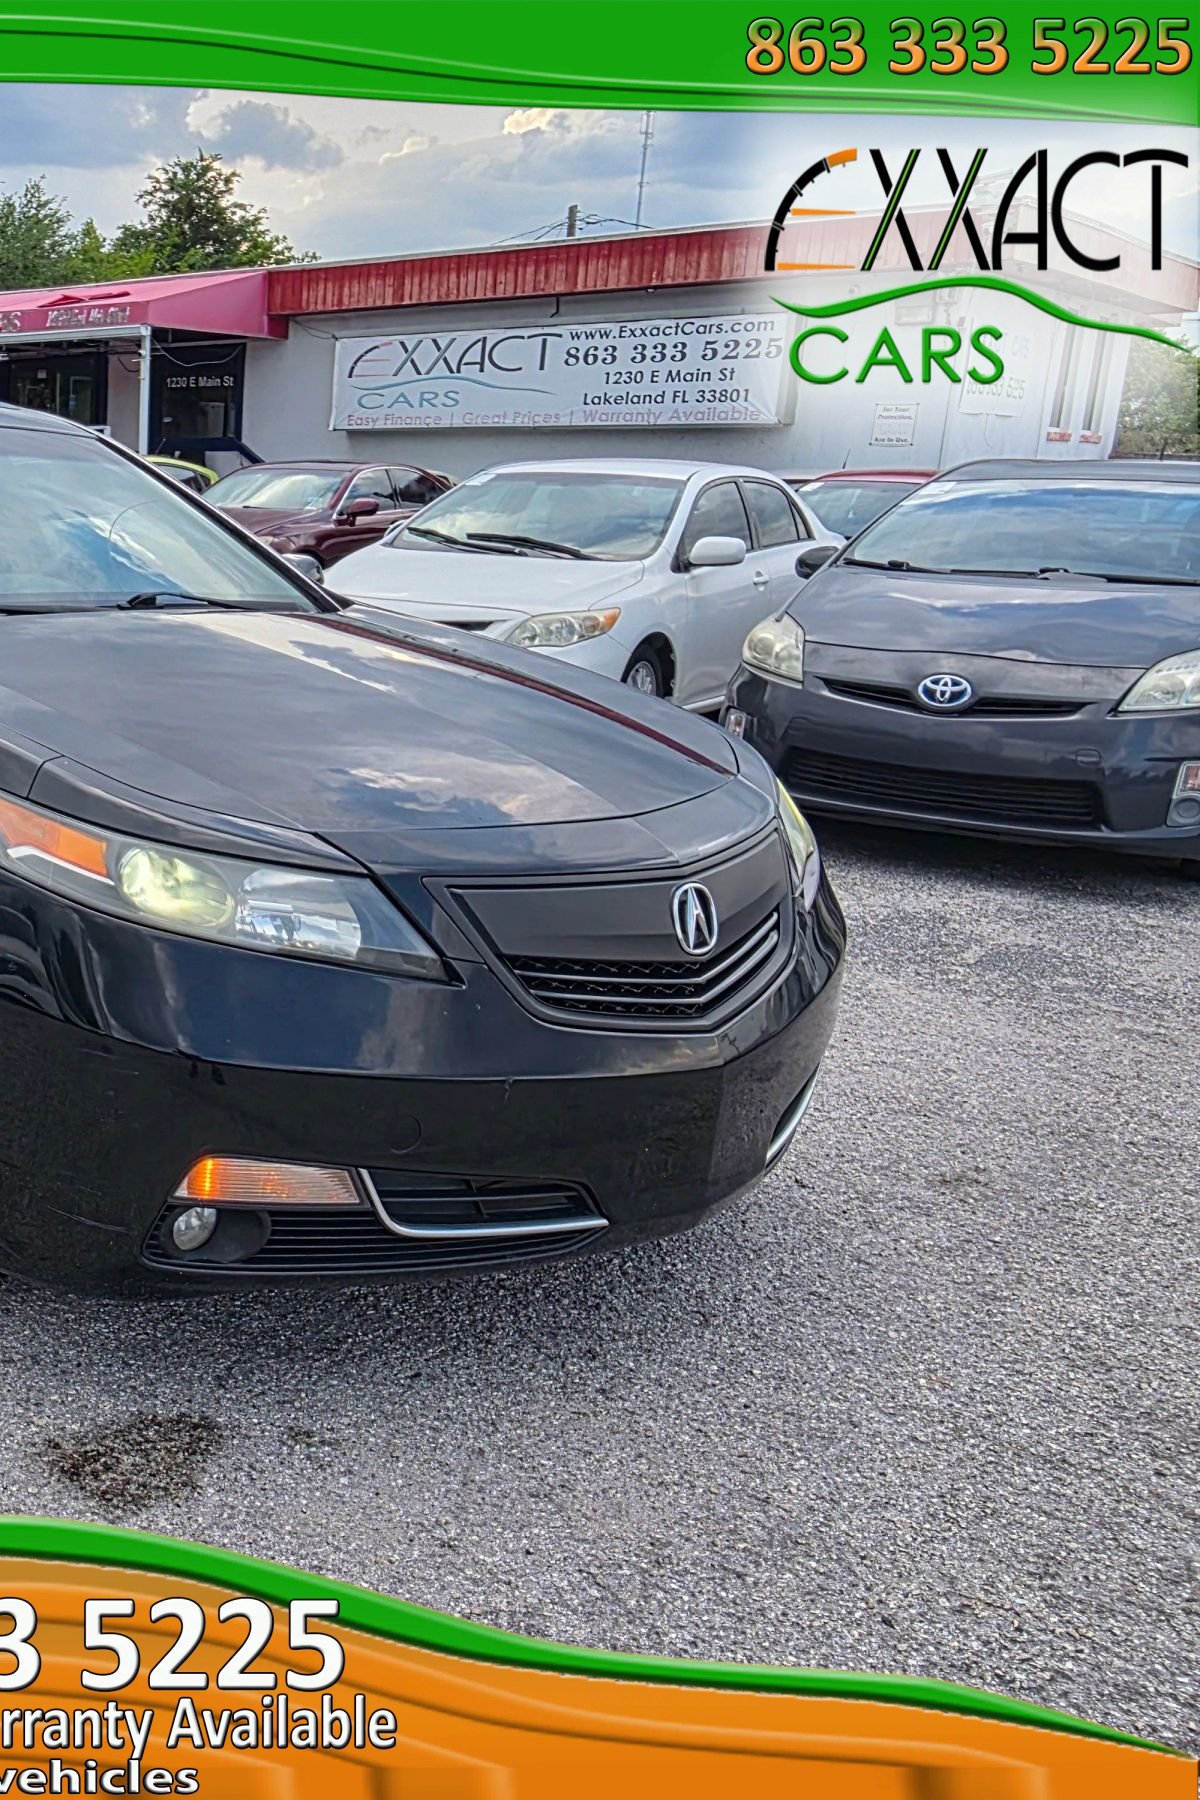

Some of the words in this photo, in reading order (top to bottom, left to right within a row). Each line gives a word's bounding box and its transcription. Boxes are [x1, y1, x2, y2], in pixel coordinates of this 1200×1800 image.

[569, 319, 775, 341] www.ExxactCars.com
[348, 332, 563, 378] EXXACT
[564, 344, 618, 367] 863
[630, 341, 688, 364] 333
[701, 337, 784, 361] 5225
[166, 376, 187, 388] 1230
[189, 376, 196, 387] E
[198, 376, 221, 387] Main
[222, 375, 234, 386] St
[603, 370, 644, 385] 1230
[650, 370, 660, 384] E
[664, 368, 712, 384] Main
[718, 366, 736, 382] St
[357, 390, 460, 410] CARS
[583, 390, 666, 406] Lakeland
[672, 390, 690, 404] FL
[695, 388, 750, 404] 33801
[347, 414, 379, 428] Easy
[383, 413, 442, 426] Finance
[462, 410, 507, 425] Great
[512, 410, 560, 426] Prices
[583, 408, 663, 425] Warranty
[669, 406, 760, 424] Available
